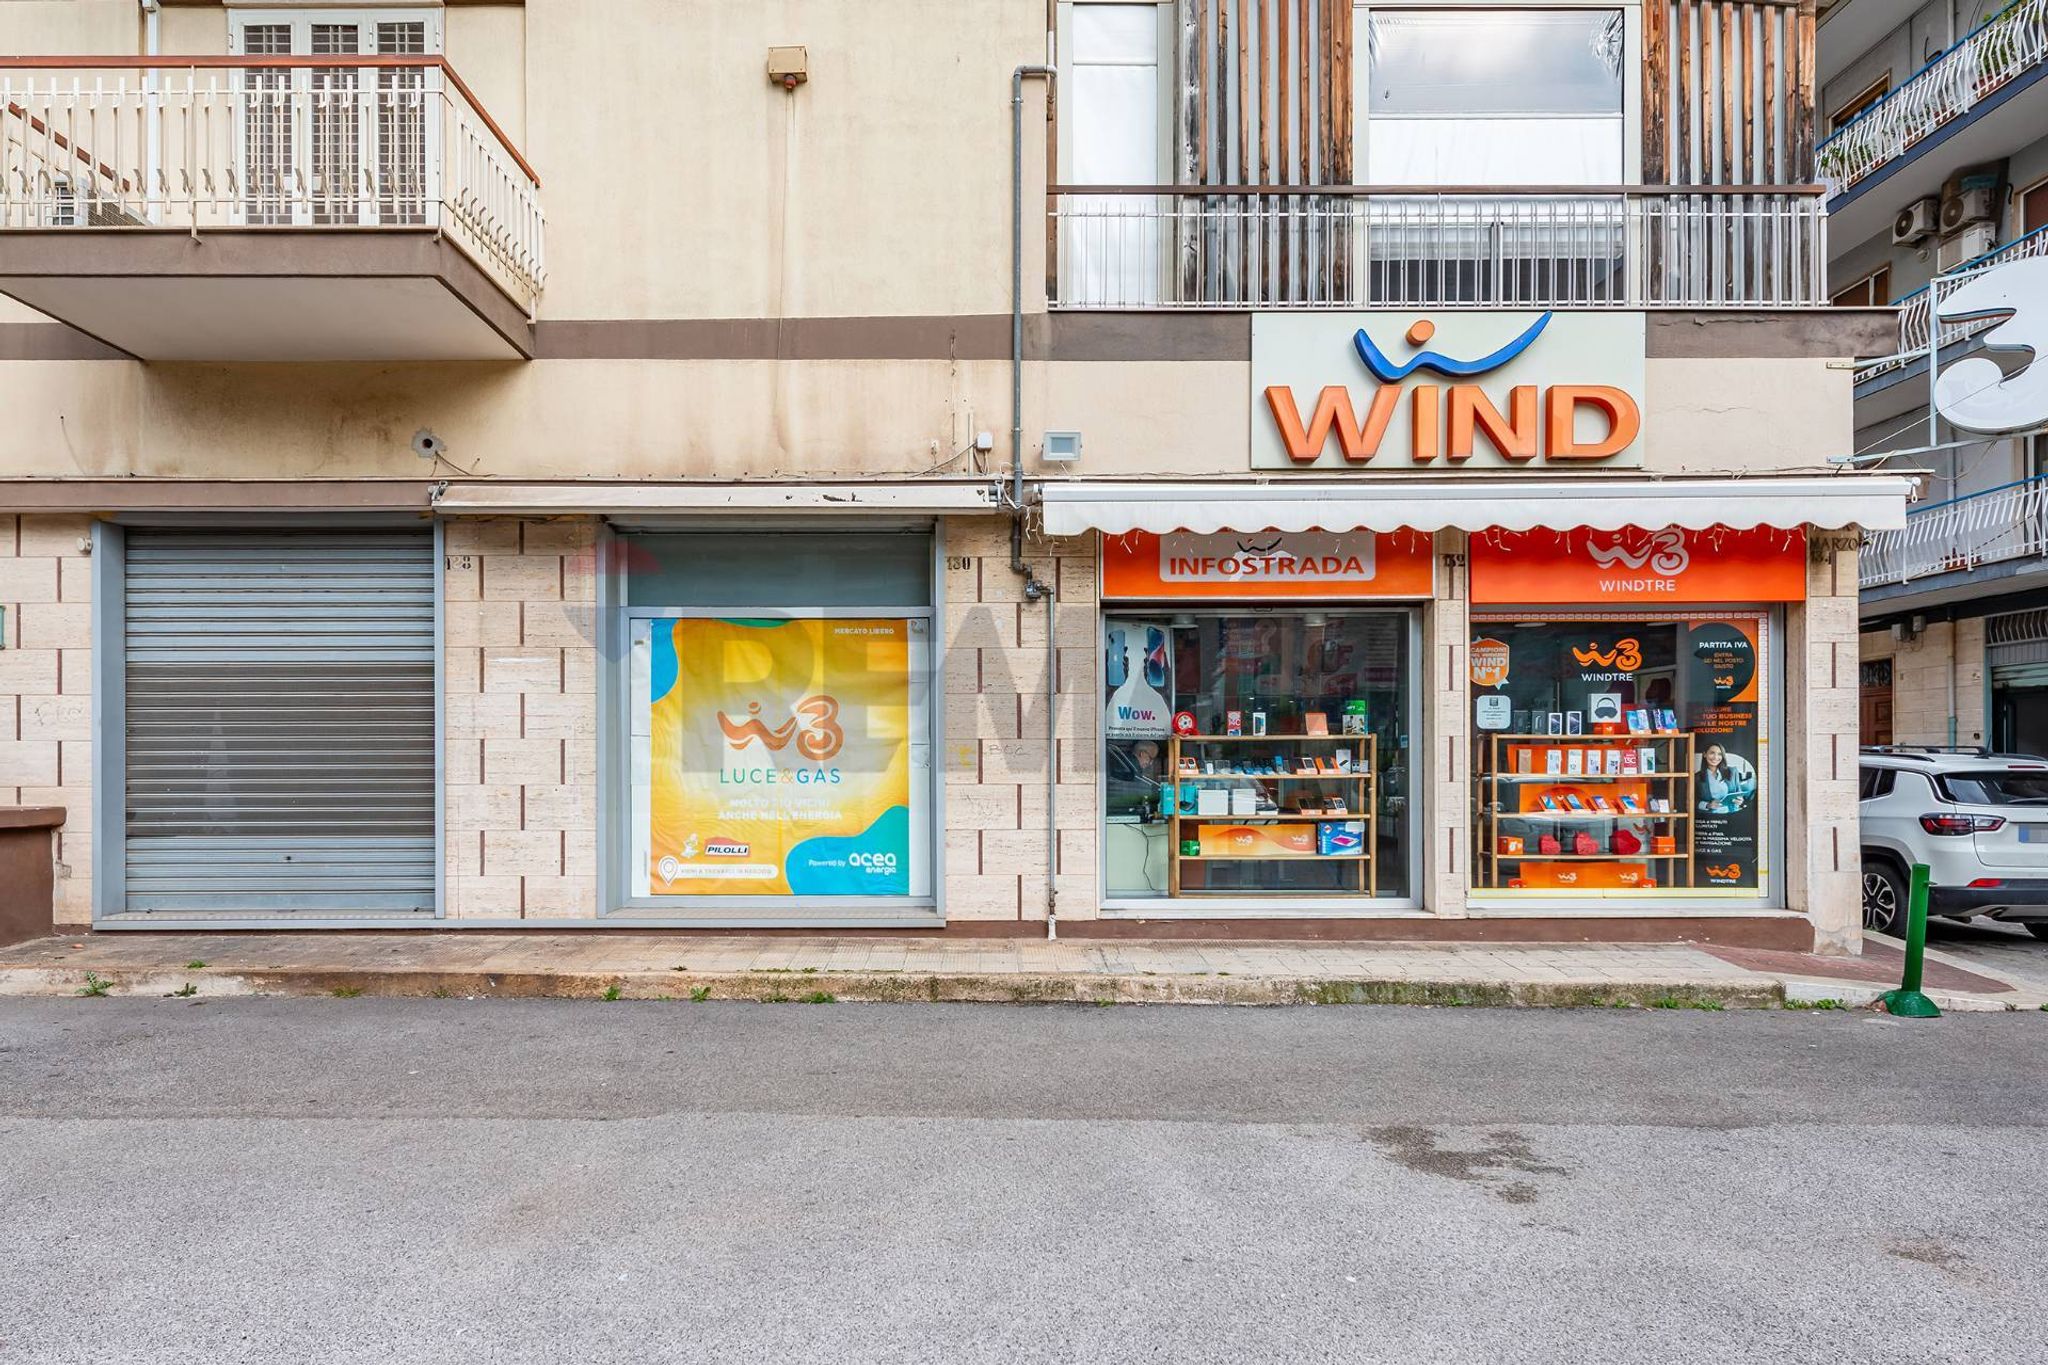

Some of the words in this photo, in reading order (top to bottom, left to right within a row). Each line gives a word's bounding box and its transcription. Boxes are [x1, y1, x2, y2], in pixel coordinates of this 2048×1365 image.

[1264, 384, 1641, 463] WIND
[947, 556, 970, 570] 130
[1170, 556, 1364, 575] INFOSTRADA
[1600, 580, 1676, 592] WINDTRE
[834, 627, 868, 635] MERCATO
[869, 627, 895, 635] LIBERO
[1472, 658, 1505, 666] WIND
[1581, 673, 1633, 682] WINDTRE
[1118, 706, 1156, 720] Wow.
[718, 811, 757, 820] ANCHE
[707, 846, 748, 854] PILOLLI
[808, 859, 837, 867] Powered
[838, 859, 846, 868] by
[849, 853, 896, 867] acea
[866, 866, 896, 876] energia
